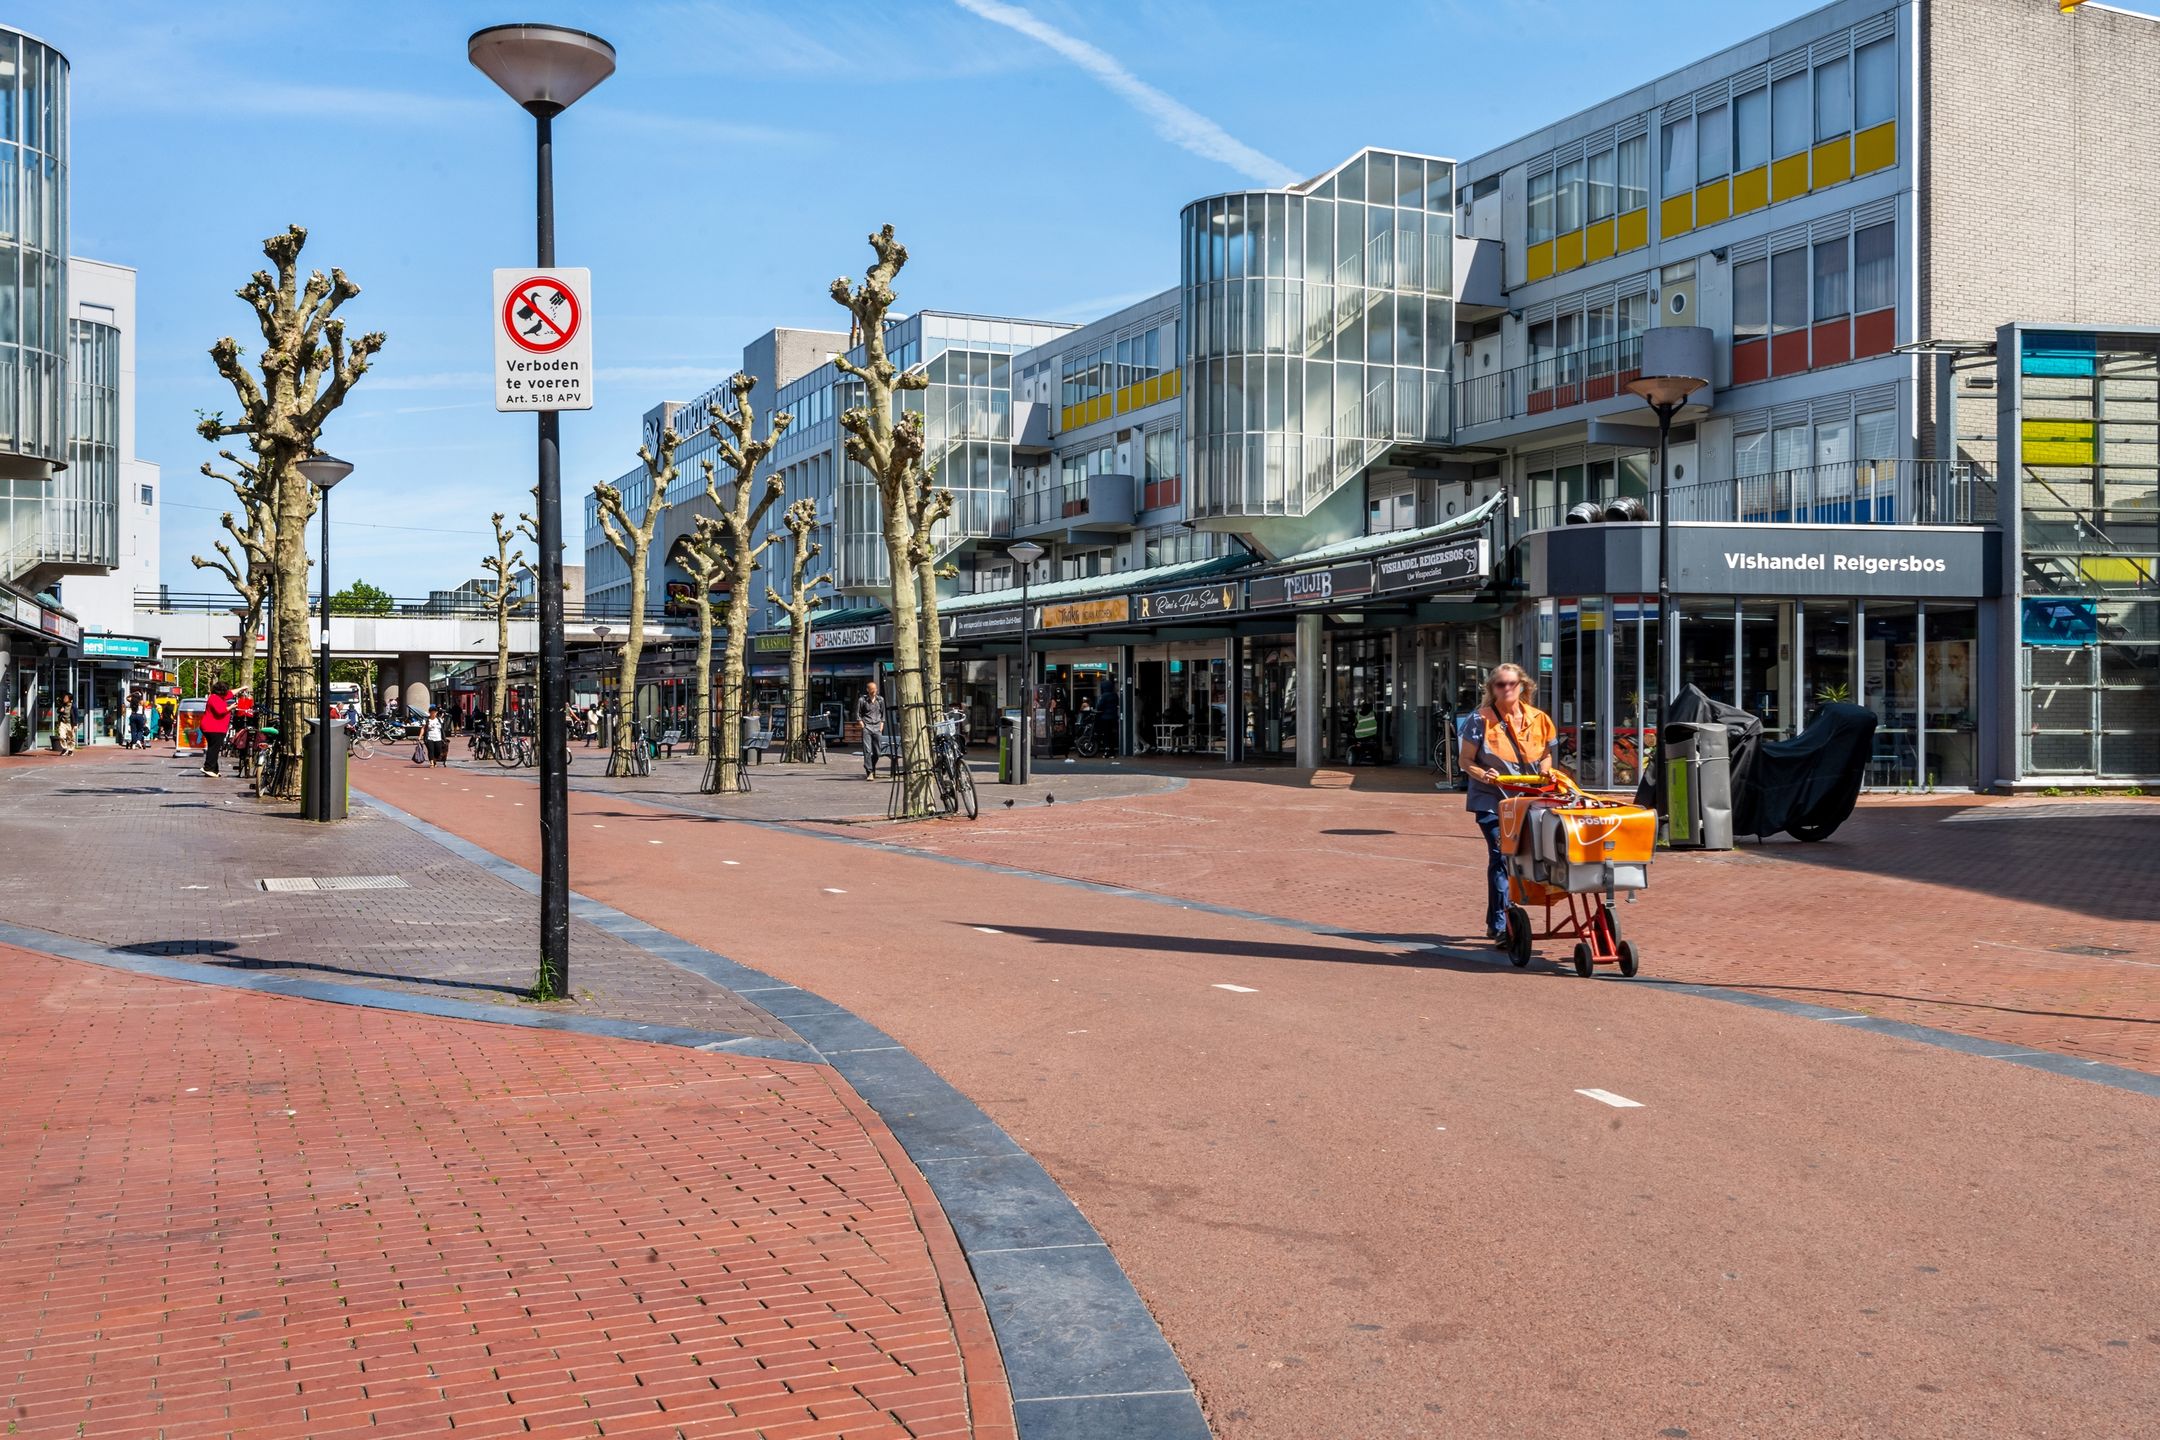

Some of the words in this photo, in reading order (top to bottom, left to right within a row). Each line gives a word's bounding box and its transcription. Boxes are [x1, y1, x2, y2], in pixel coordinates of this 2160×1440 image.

[506, 359, 579, 372] Verboden
[506, 378, 521, 389] te
[528, 378, 580, 389] voeren
[506, 395, 528, 403] Art.
[531, 394, 554, 403] 5.18
[557, 393, 581, 402] APV
[1380, 557, 1419, 575] VISHANDEL
[1419, 548, 1464, 567] REIGERSBOS
[1724, 553, 1825, 570] Vishandel
[1833, 554, 1946, 574] Reigersbos
[1406, 572, 1415, 581] Uw
[1284, 572, 1332, 601] TEUJIB
[1141, 598, 1150, 617] R
[1178, 593, 1199, 611] Hair
[1199, 589, 1219, 609] Salon
[824, 631, 842, 647] HANS
[842, 628, 869, 646] ANDERS
[84, 642, 104, 653] eers
